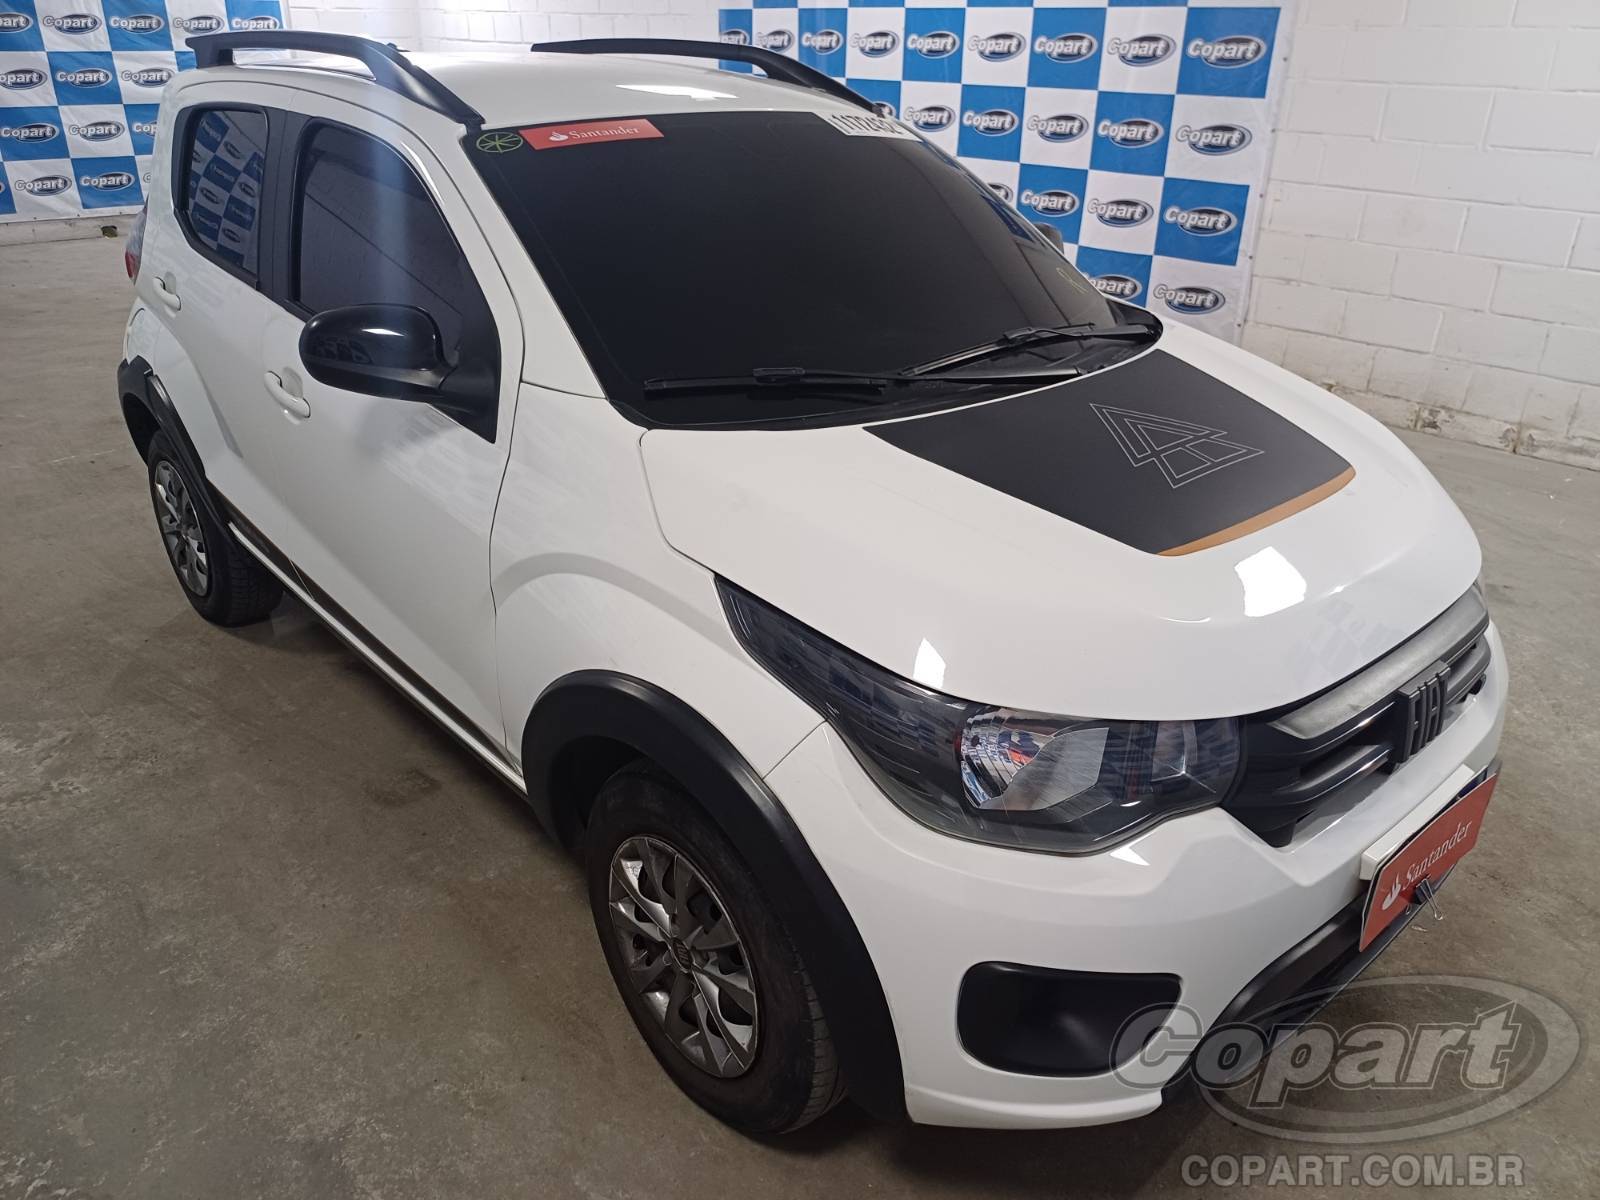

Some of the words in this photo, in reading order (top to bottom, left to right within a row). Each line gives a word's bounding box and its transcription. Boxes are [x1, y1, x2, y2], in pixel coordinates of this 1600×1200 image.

[43, 16, 93, 29] Copart
[110, 16, 157, 29] Copart
[174, 17, 218, 30] Copart
[232, 17, 275, 29] Copart
[756, 33, 788, 46] Copart
[802, 33, 836, 46] Copart
[851, 33, 892, 48] Copart
[908, 34, 952, 50] Copart
[968, 36, 1018, 54] Copart
[1034, 36, 1093, 56] Copart
[1108, 38, 1166, 59] Copart
[1187, 39, 1254, 60] Copart
[57, 71, 105, 85] Copart
[121, 71, 168, 84] Copart
[905, 107, 949, 125] Copart
[963, 110, 1011, 130] Copart
[1, 126, 52, 140] Copart
[69, 125, 117, 138] Copart
[569, 126, 639, 139] Santander
[1027, 115, 1080, 135] Copart
[1098, 120, 1153, 142] Copart
[1176, 125, 1240, 149] Copart
[16, 178, 64, 191] Copart
[82, 176, 128, 188] Copart
[1021, 190, 1072, 211] Copart
[1087, 199, 1144, 220] Copart
[1165, 207, 1227, 230] Copart
[1154, 284, 1216, 308] Copart
[1401, 821, 1472, 890] Santander
